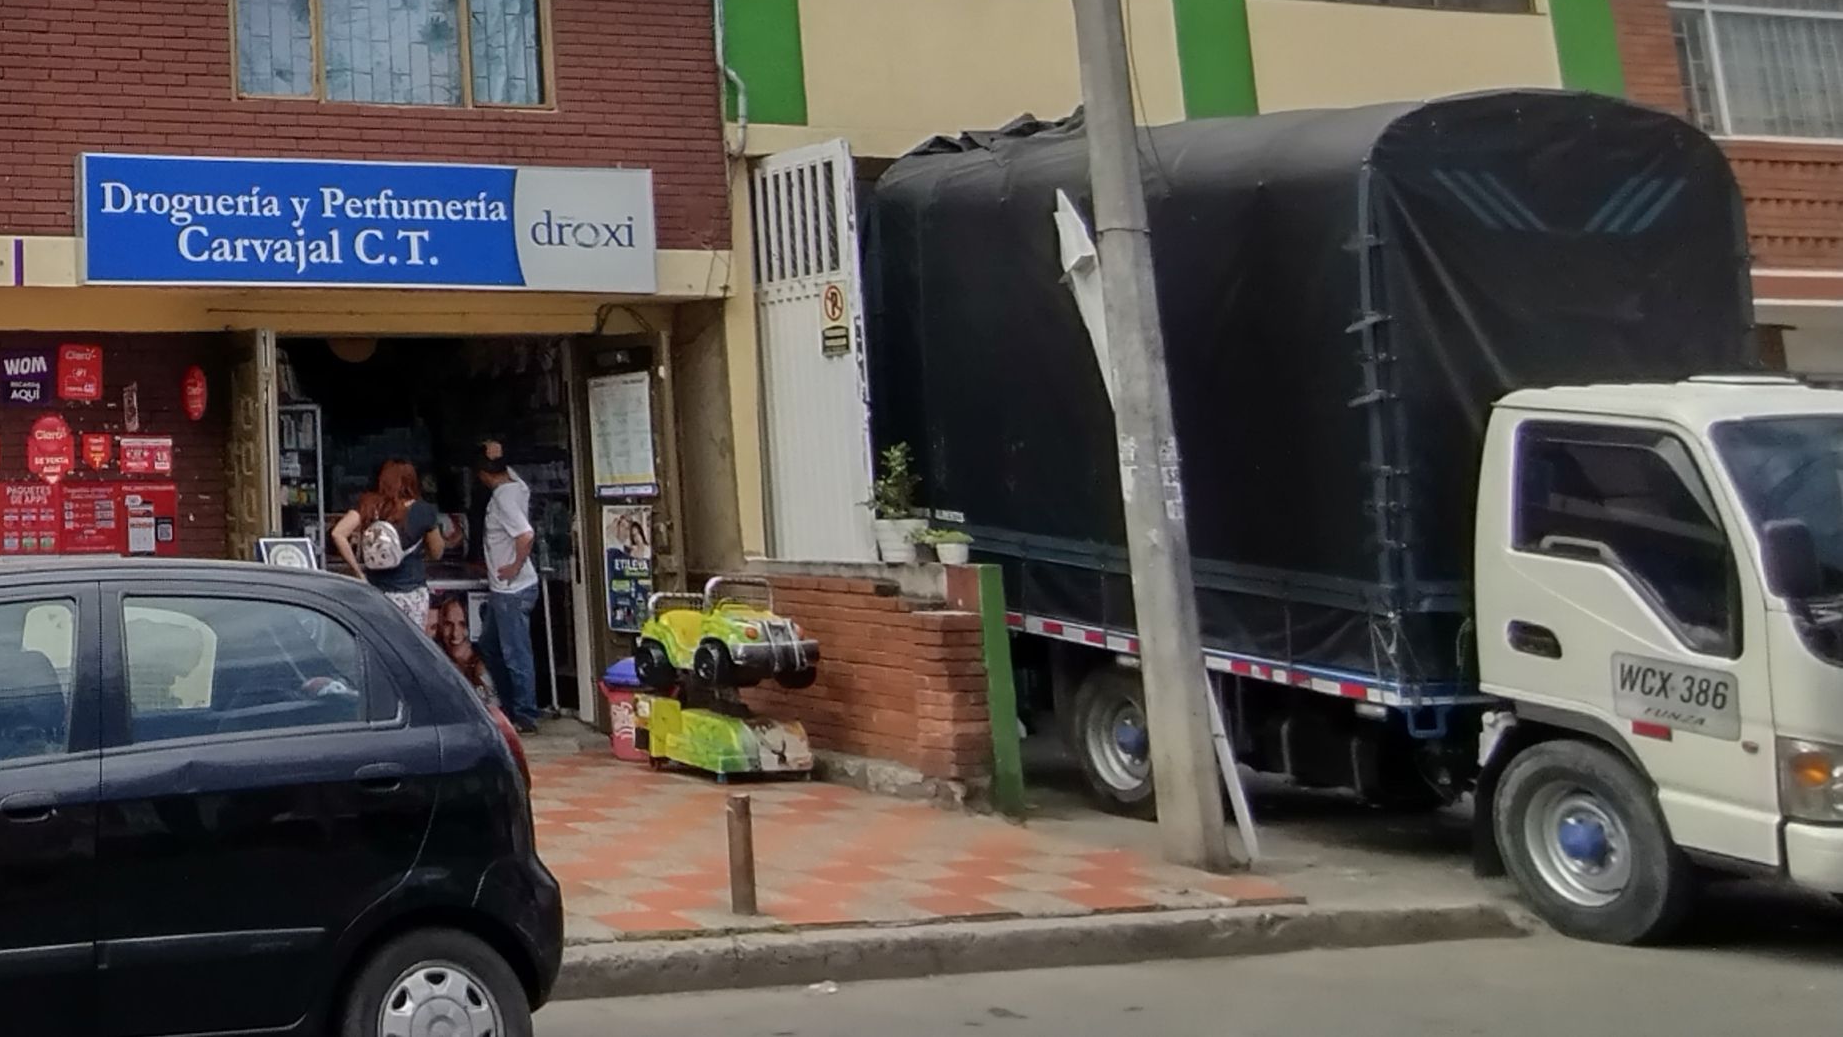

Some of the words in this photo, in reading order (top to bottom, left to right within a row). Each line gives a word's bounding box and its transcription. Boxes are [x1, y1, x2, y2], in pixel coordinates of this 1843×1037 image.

[100, 183, 281, 224] Droguería
[290, 196, 311, 228] y
[319, 187, 507, 222] Perfumería
[177, 226, 344, 273] Carvajal
[353, 230, 439, 265] C.T.
[531, 209, 635, 248] droxi
[3, 356, 47, 376] WOM
[1619, 663, 1673, 699] WCX
[1680, 675, 1729, 710] 386
